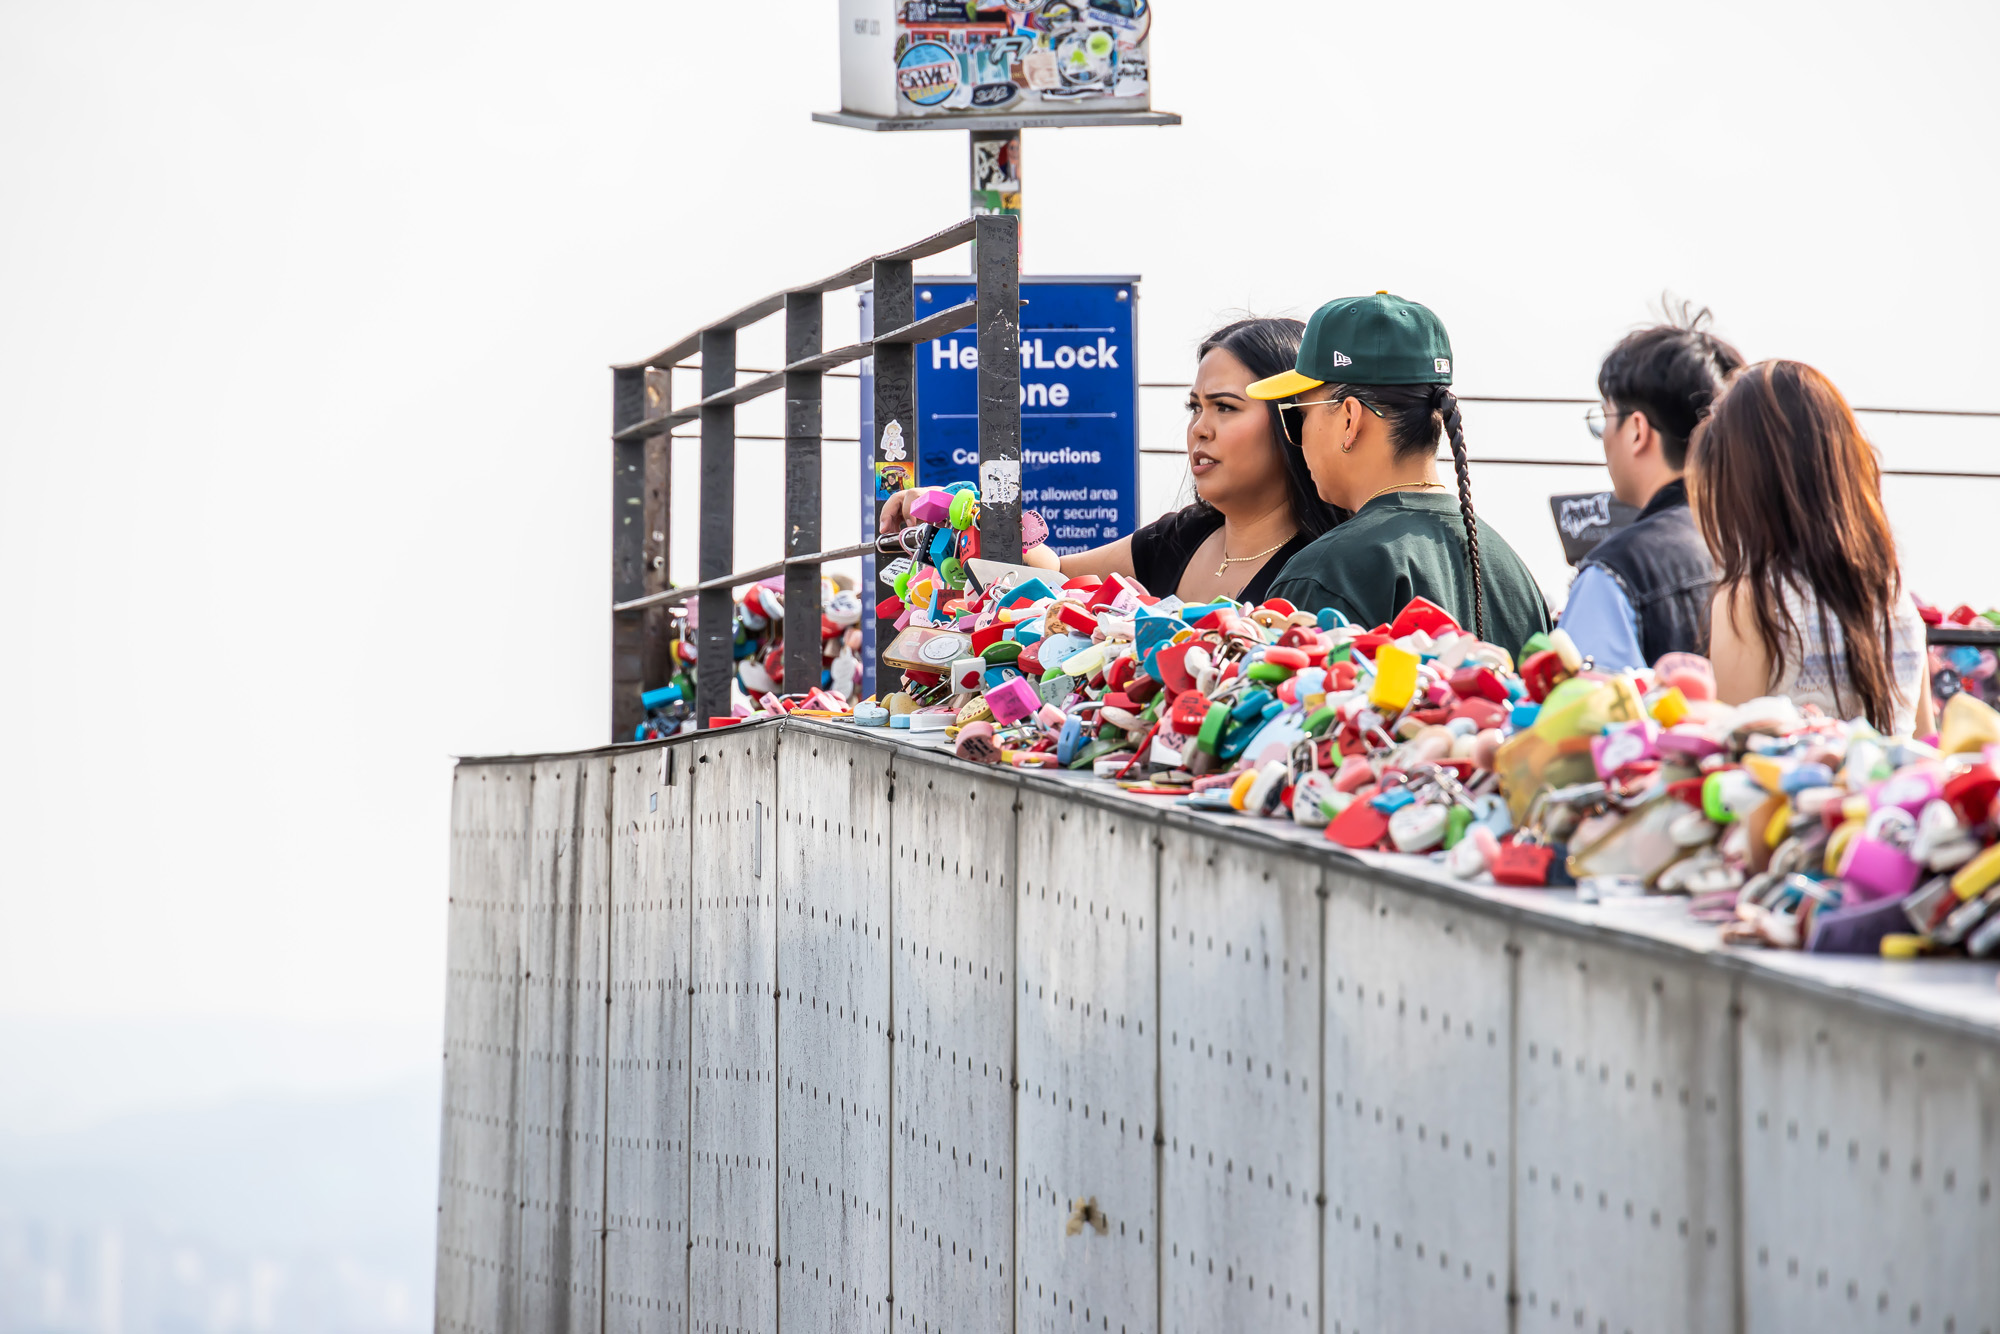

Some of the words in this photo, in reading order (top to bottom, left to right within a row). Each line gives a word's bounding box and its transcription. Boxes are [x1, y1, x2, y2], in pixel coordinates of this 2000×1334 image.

[932, 338, 1119, 369] HetLock
[1021, 447, 1101, 464] structions
[1040, 486, 1087, 501] allowed
[1089, 489, 1118, 501] area
[1041, 506, 1060, 520] for
[1063, 505, 1118, 522] securing
[1052, 523, 1100, 538] 'citizen'
[1102, 526, 1119, 538] as
[1021, 533, 1048, 547] Marissa
